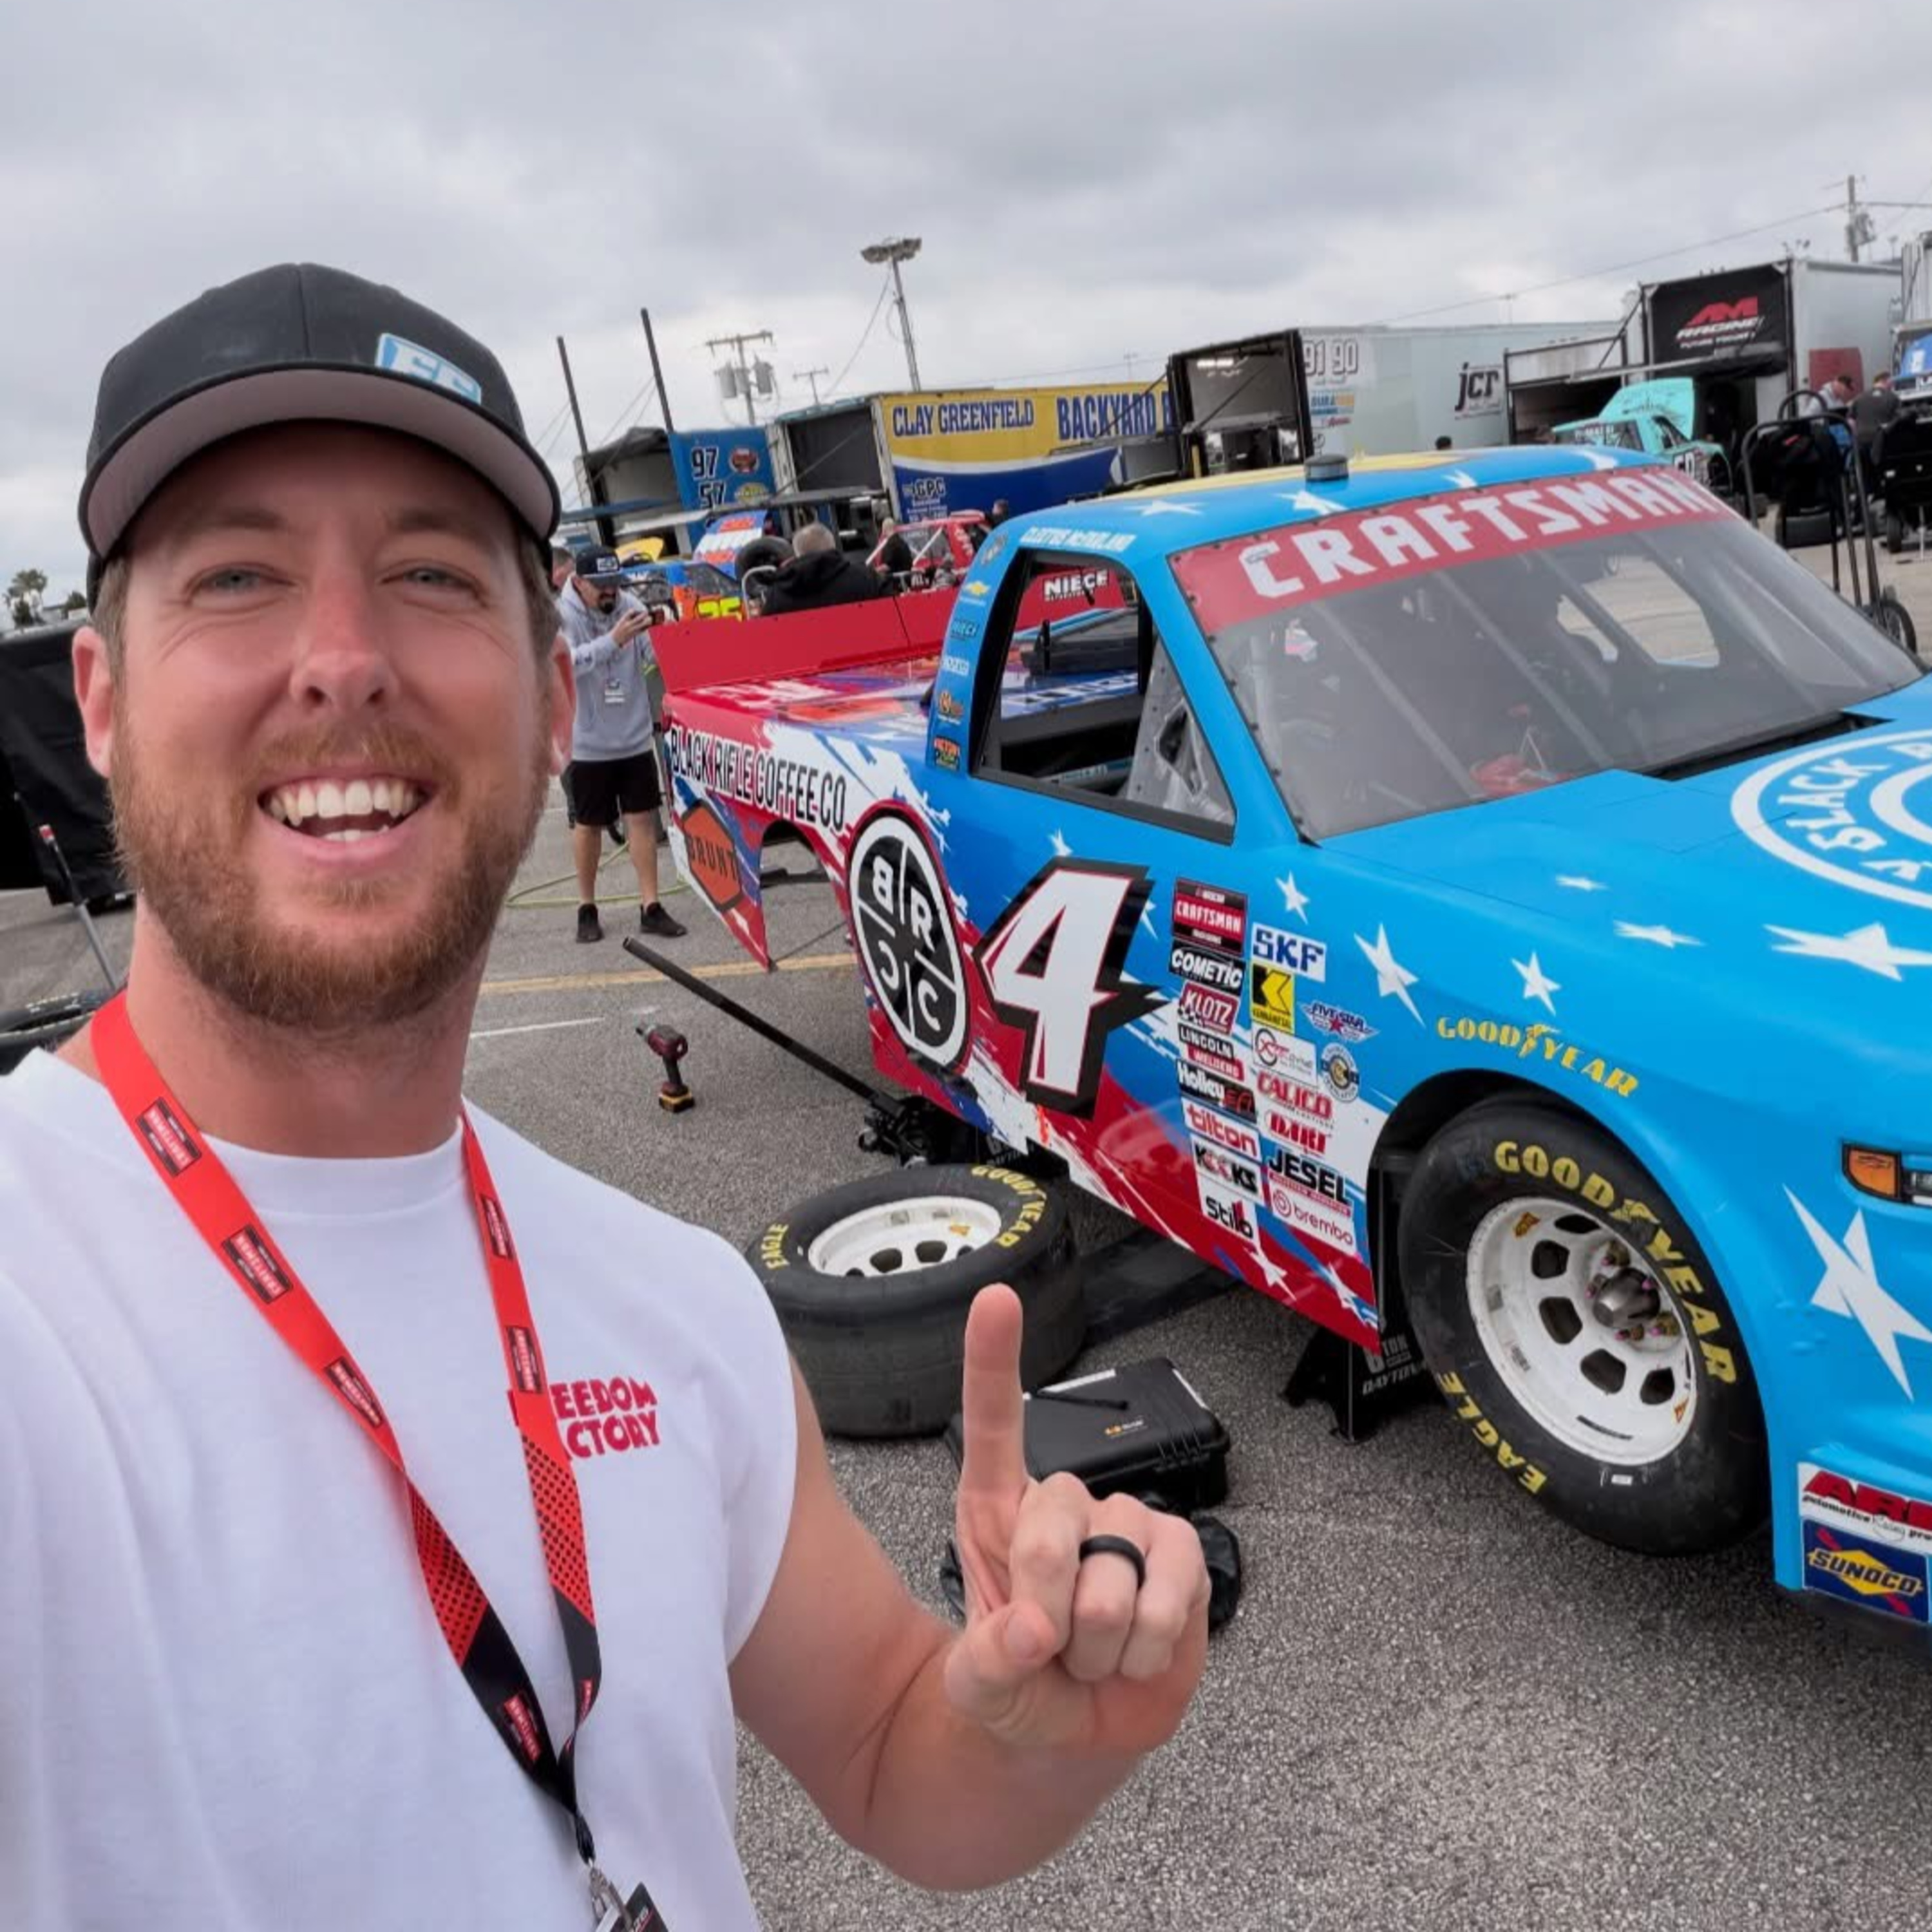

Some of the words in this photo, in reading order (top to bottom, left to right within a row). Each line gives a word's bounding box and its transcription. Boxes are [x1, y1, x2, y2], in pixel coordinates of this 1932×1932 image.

[1303, 340, 1325, 376] 91
[1332, 338, 1358, 375] 90
[893, 402, 936, 437] CLAY
[937, 399, 1034, 433] GREENFIELD
[1057, 392, 1157, 441] BACKYARD
[692, 446, 719, 481] 97
[699, 480, 726, 509] 57
[1238, 471, 1721, 598] CRAFTSMAN
[1044, 569, 1108, 596] NIECE
[672, 728, 710, 783] BLACK
[714, 739, 753, 800] RIFLE
[756, 753, 818, 822] COFFEE
[820, 772, 846, 831] CO
[1176, 900, 1242, 934] CRAFTSMAN
[1171, 948, 1243, 989] COMETIC
[1253, 927, 1324, 973] SKF
[975, 861, 1140, 1109] 4
[1184, 989, 1233, 1026] KLOTZ
[1180, 1027, 1233, 1057] LINCOLN
[1193, 1048, 1240, 1079] WELDERS
[1437, 1016, 1639, 1097] GOODYEAR
[1177, 1058, 1225, 1107] Holley
[1257, 1070, 1333, 1120] CALICO
[1186, 1104, 1258, 1157] tilton
[1268, 1148, 1352, 1206] JESEL
[971, 1164, 1048, 1249] GOODYEAR
[1206, 1195, 1254, 1240] Stilo
[1293, 1202, 1354, 1246] brembo
[761, 1223, 791, 1269] EAGLE
[1493, 1140, 1739, 1385] GOODYEAR
[507, 1376, 658, 1426] EEDOM
[558, 1410, 659, 1460] CTORY
[1437, 1371, 1547, 1493] EAGLE
[1803, 1494, 1870, 1522] automotive
[1812, 1549, 1920, 1594] SUNOCO
